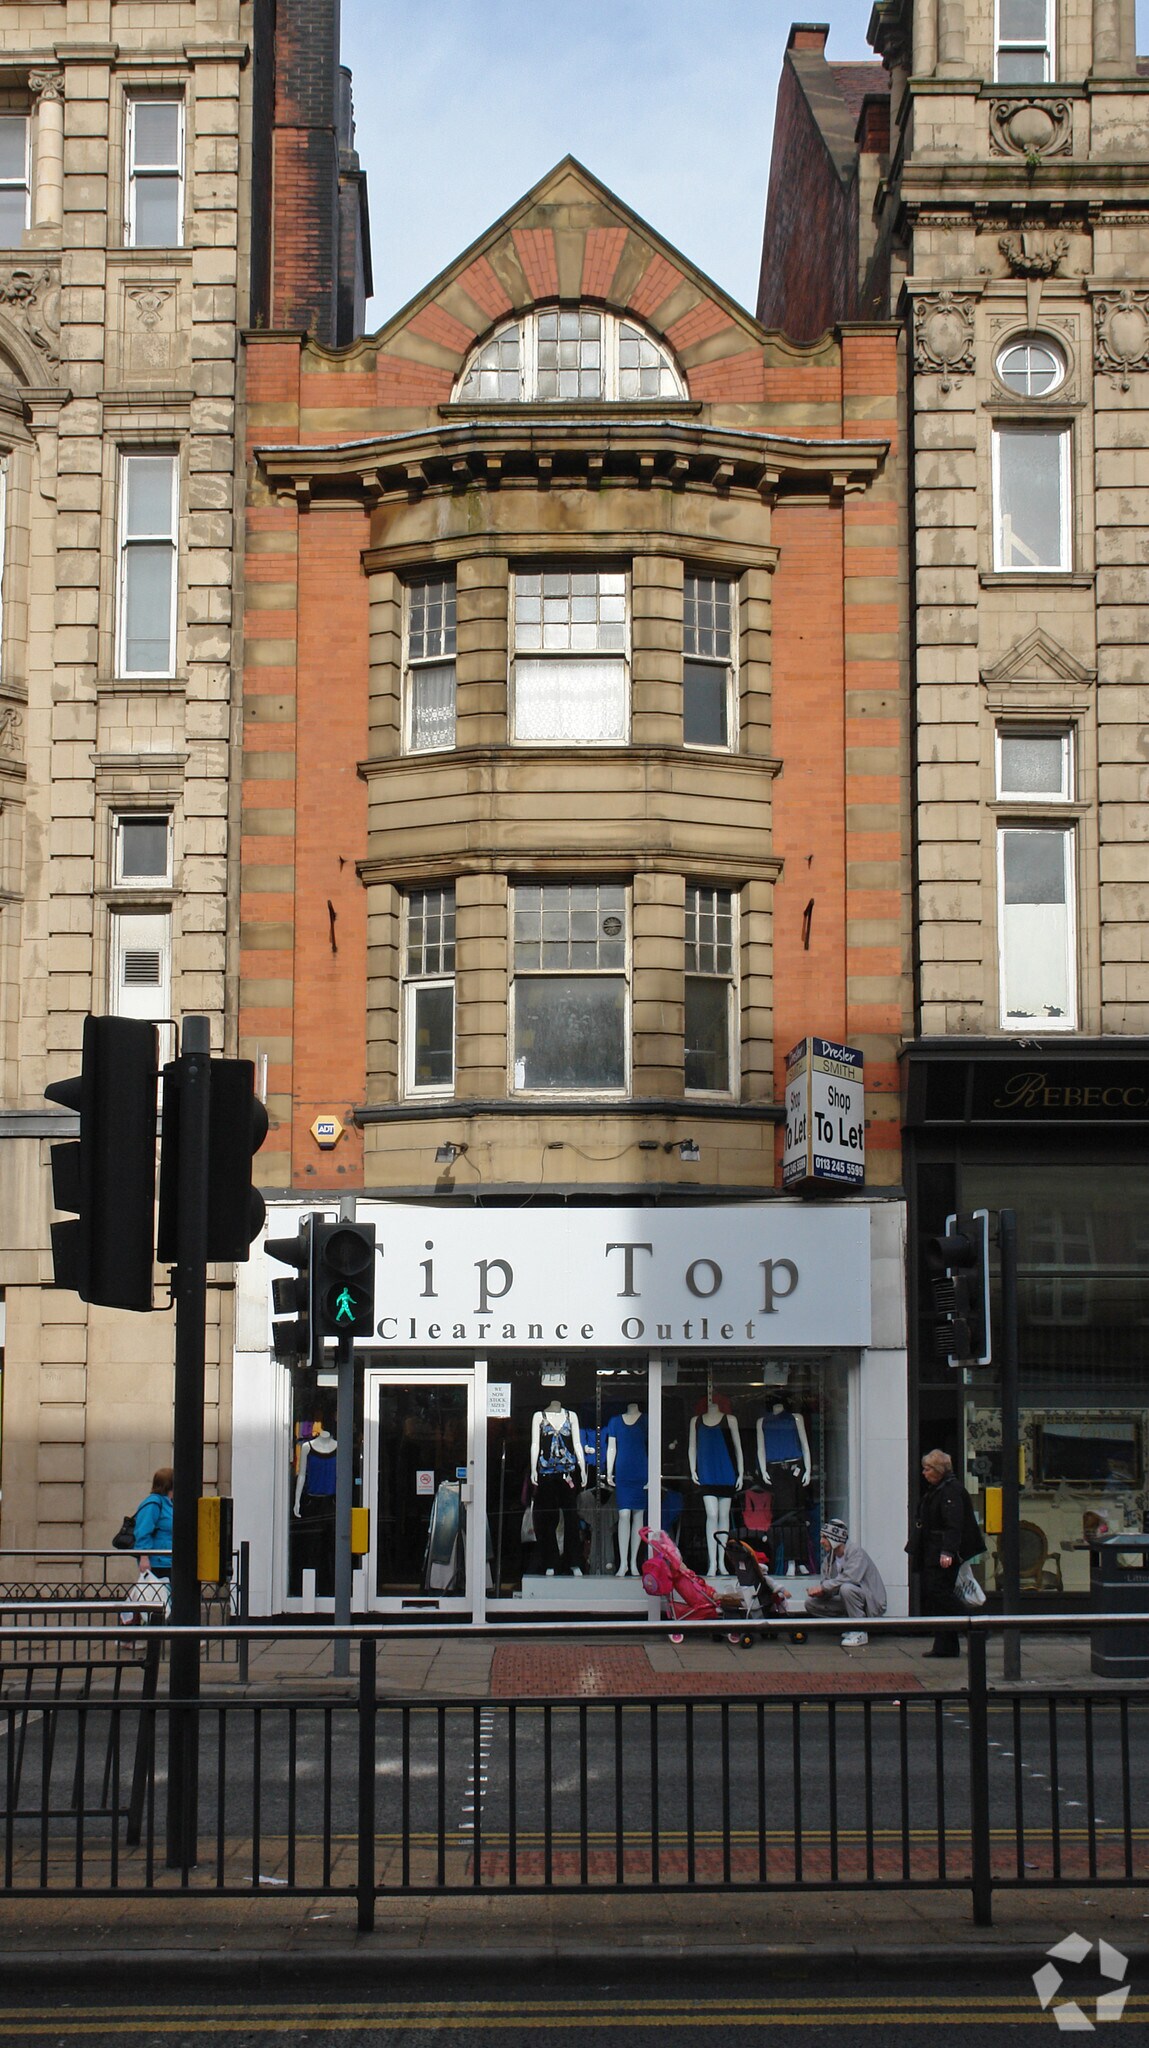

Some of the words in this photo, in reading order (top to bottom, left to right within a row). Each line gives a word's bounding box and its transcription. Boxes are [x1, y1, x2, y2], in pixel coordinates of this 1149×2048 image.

[821, 1041, 856, 1063] Dresler
[823, 1060, 855, 1079] SMITH
[828, 1085, 851, 1115] Shop
[993, 1072, 1149, 1108] REBECC
[318, 1125, 334, 1133] ADT
[784, 1123, 792, 1151] To
[794, 1113, 806, 1146] Let
[814, 1111, 833, 1143] To
[839, 1117, 863, 1151] Let
[815, 1156, 831, 1170] 0113
[831, 1160, 845, 1173] 245
[846, 1163, 864, 1177] 5599
[375, 1240, 514, 1314] ip
[606, 1242, 799, 1314] Top
[376, 1317, 595, 1340] Clearance
[621, 1317, 756, 1340] Outlet
